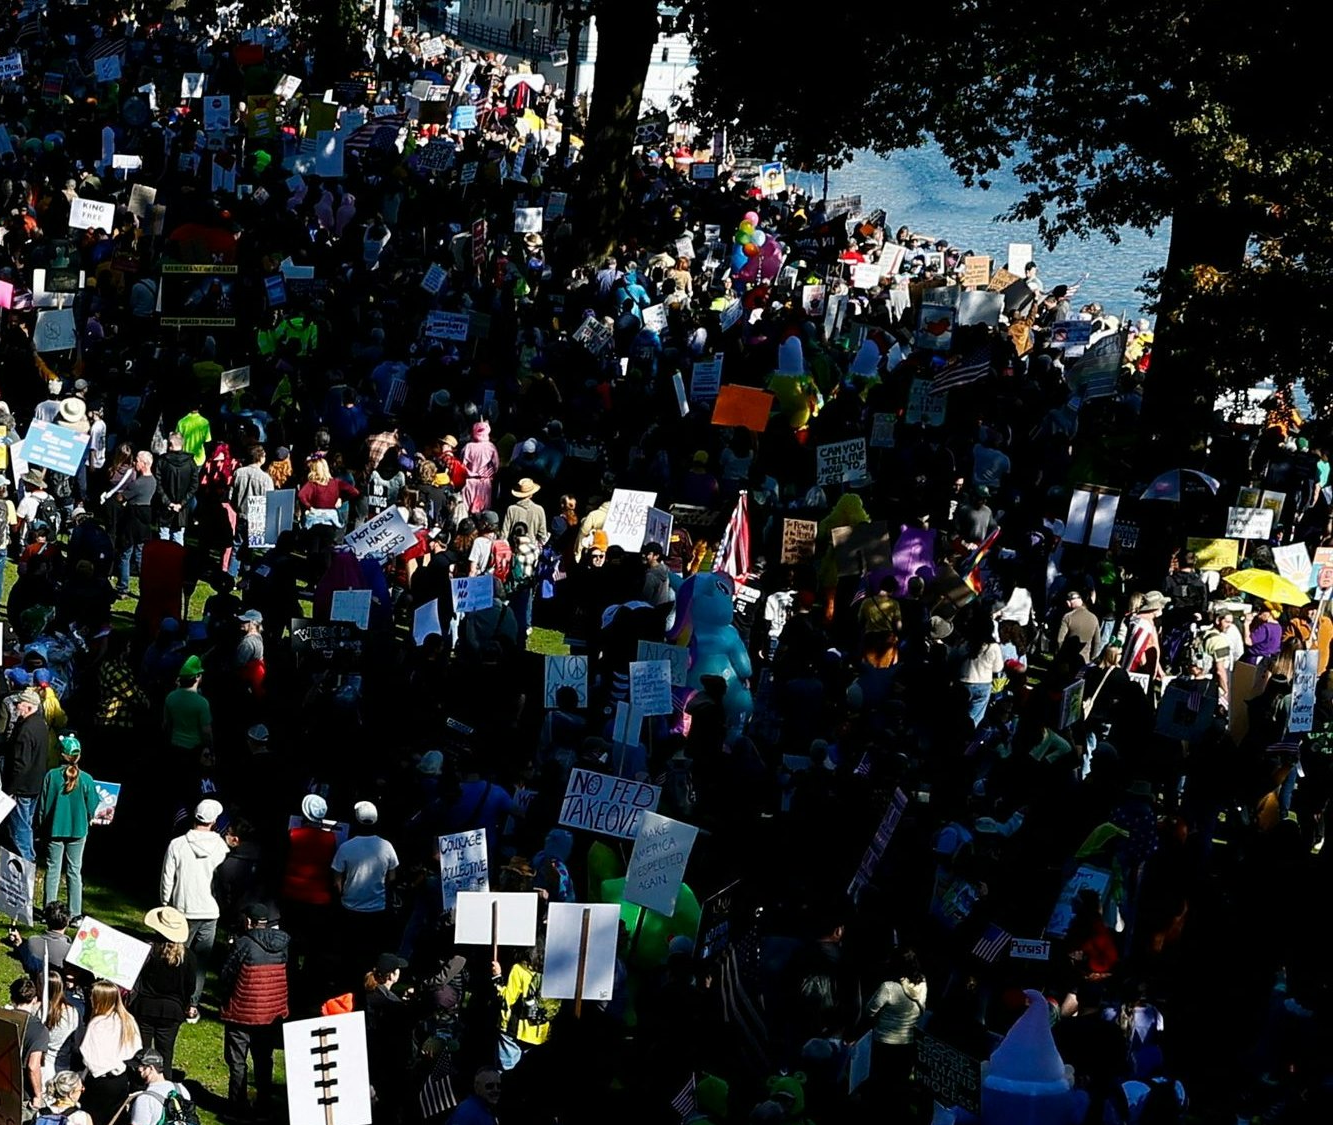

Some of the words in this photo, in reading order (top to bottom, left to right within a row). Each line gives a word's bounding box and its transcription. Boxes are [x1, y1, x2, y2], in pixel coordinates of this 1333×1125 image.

[125, 360, 133, 374] 2
[628, 493, 645, 504] NO
[351, 528, 370, 543] HOT
[369, 511, 394, 531] GIRLS
[611, 513, 647, 527] SINCE
[366, 529, 392, 548] HATE
[457, 580, 468, 589] NO
[573, 769, 603, 797] NO
[609, 781, 654, 809] FED
